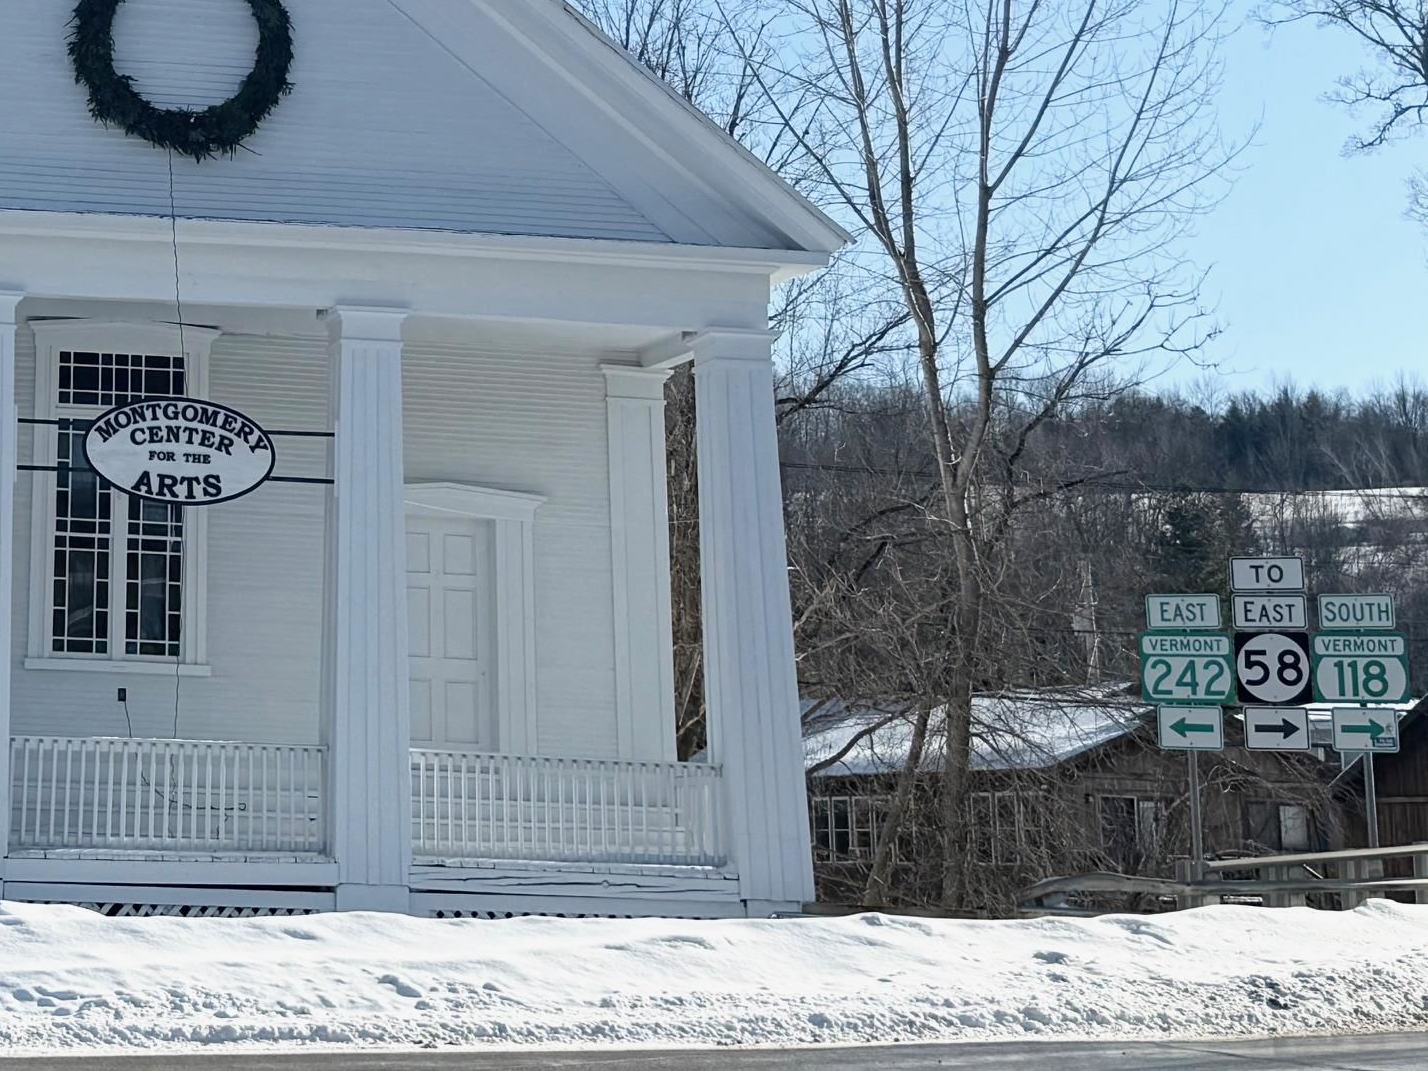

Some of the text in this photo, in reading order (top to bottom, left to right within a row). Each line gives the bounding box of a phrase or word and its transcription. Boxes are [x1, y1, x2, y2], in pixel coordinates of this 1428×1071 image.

[94, 402, 269, 454] MONTGOMERY
[129, 425, 234, 456] CENTER
[148, 450, 211, 465] FOR THE
[130, 470, 222, 500] ARTS
[1249, 564, 1284, 584] TO
[1159, 601, 1207, 624] EAST
[1244, 601, 1296, 624] EAST
[1324, 601, 1391, 623] SOUTH
[1149, 638, 1222, 652] VERMONT
[1322, 638, 1397, 653] VERMONT
[1150, 659, 1226, 696] 242
[1244, 649, 1304, 687] 58
[1333, 659, 1389, 698] 118
